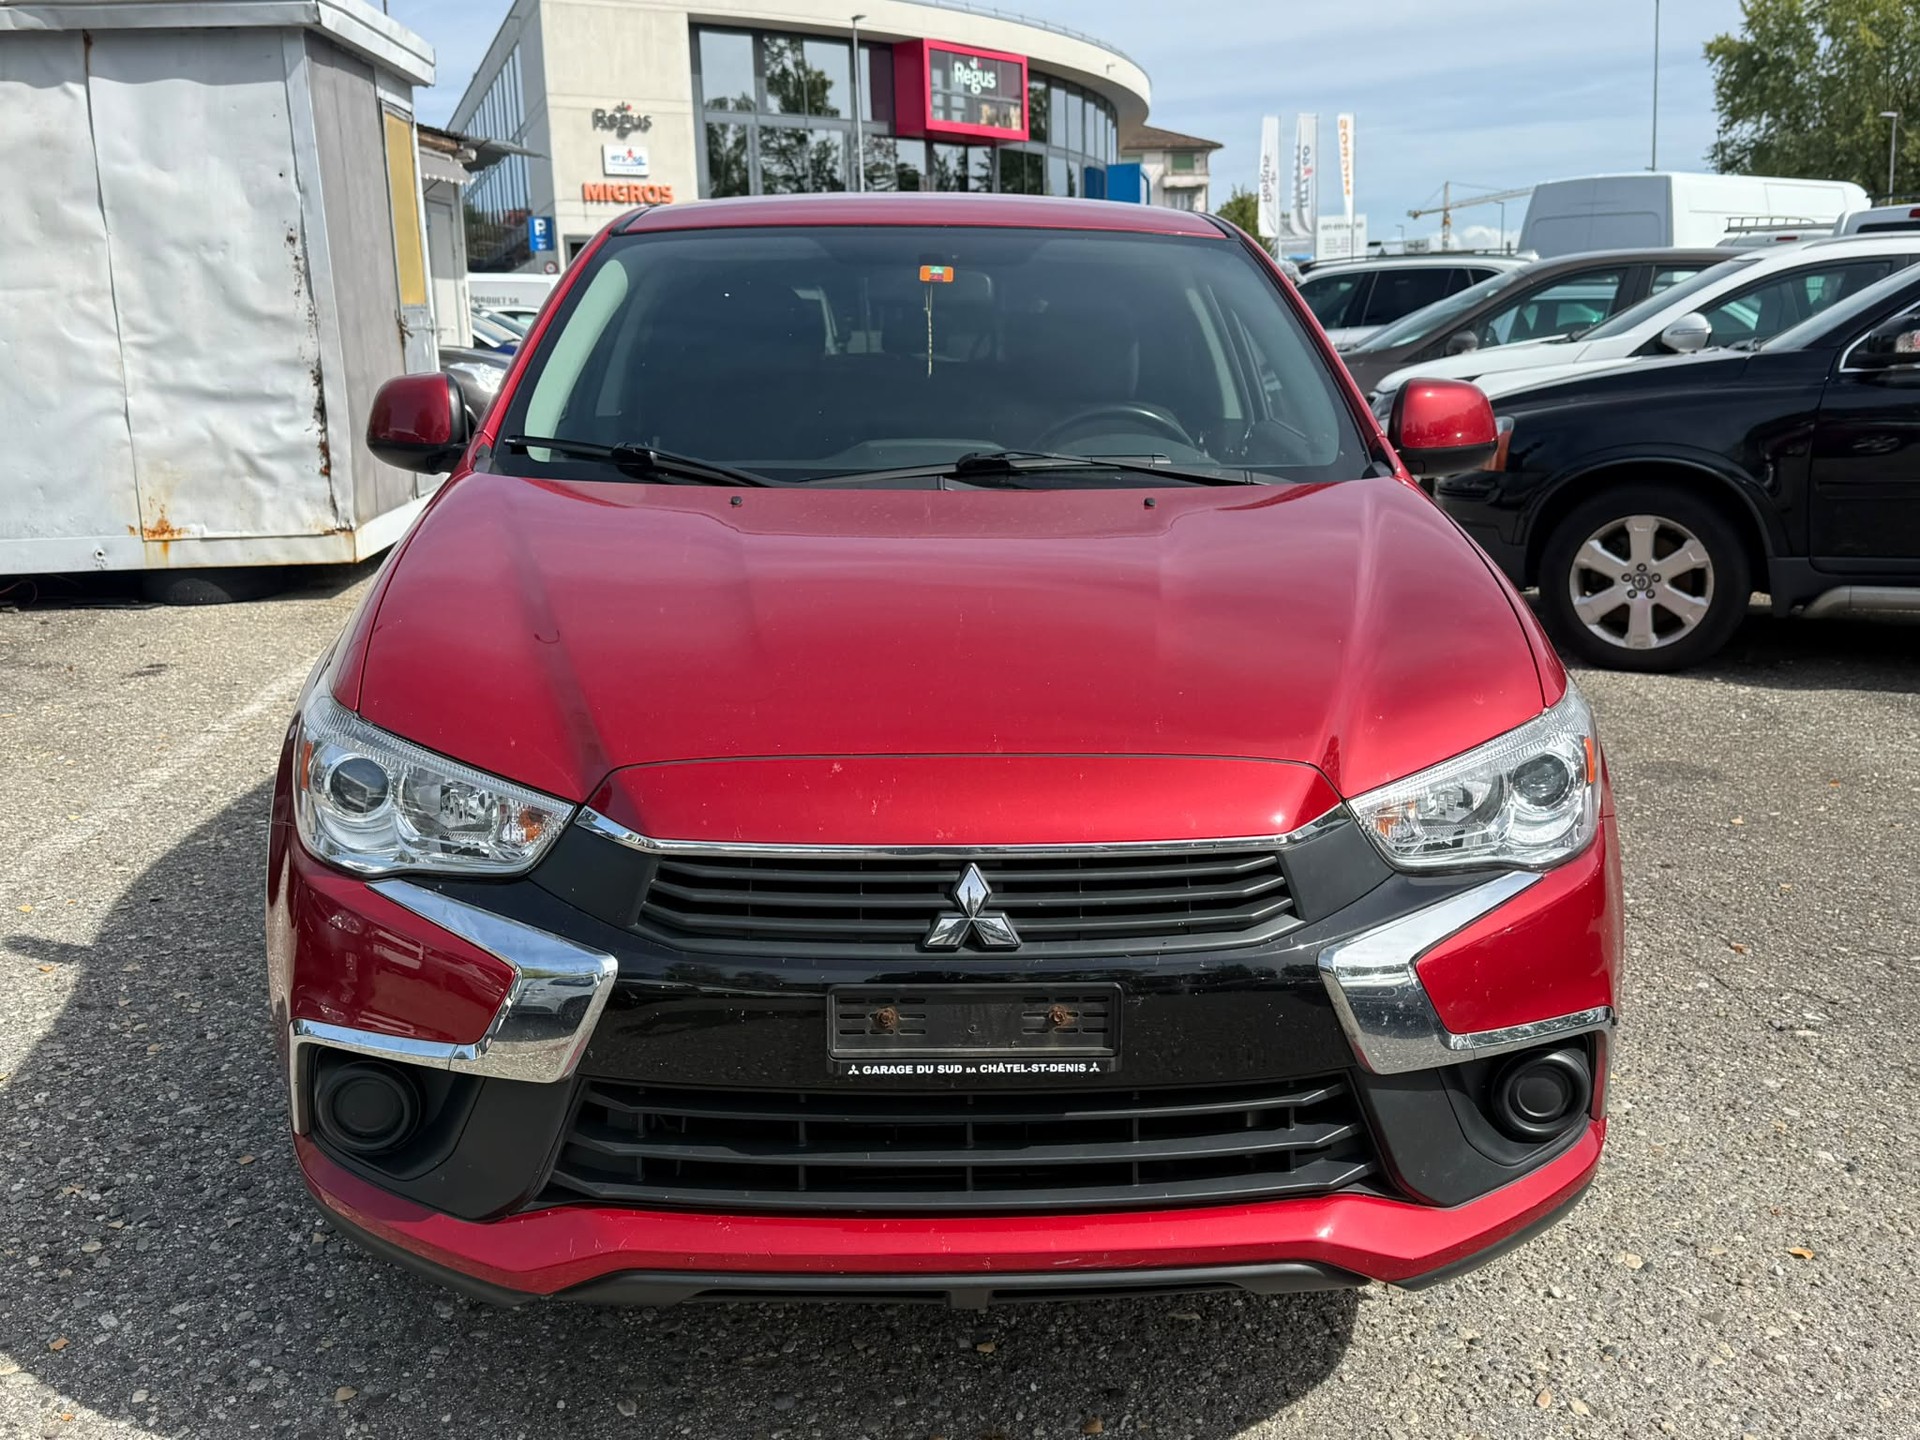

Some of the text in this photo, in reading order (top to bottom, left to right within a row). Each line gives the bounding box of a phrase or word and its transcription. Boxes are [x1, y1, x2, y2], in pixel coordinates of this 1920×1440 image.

[953, 60, 997, 95] Regus
[592, 108, 652, 140] Regus
[582, 182, 674, 205] MIGROS
[533, 218, 546, 236] P
[862, 1062, 1087, 1075] GARAGE DU SUD SA CHÂTEL-ST-DENIS
